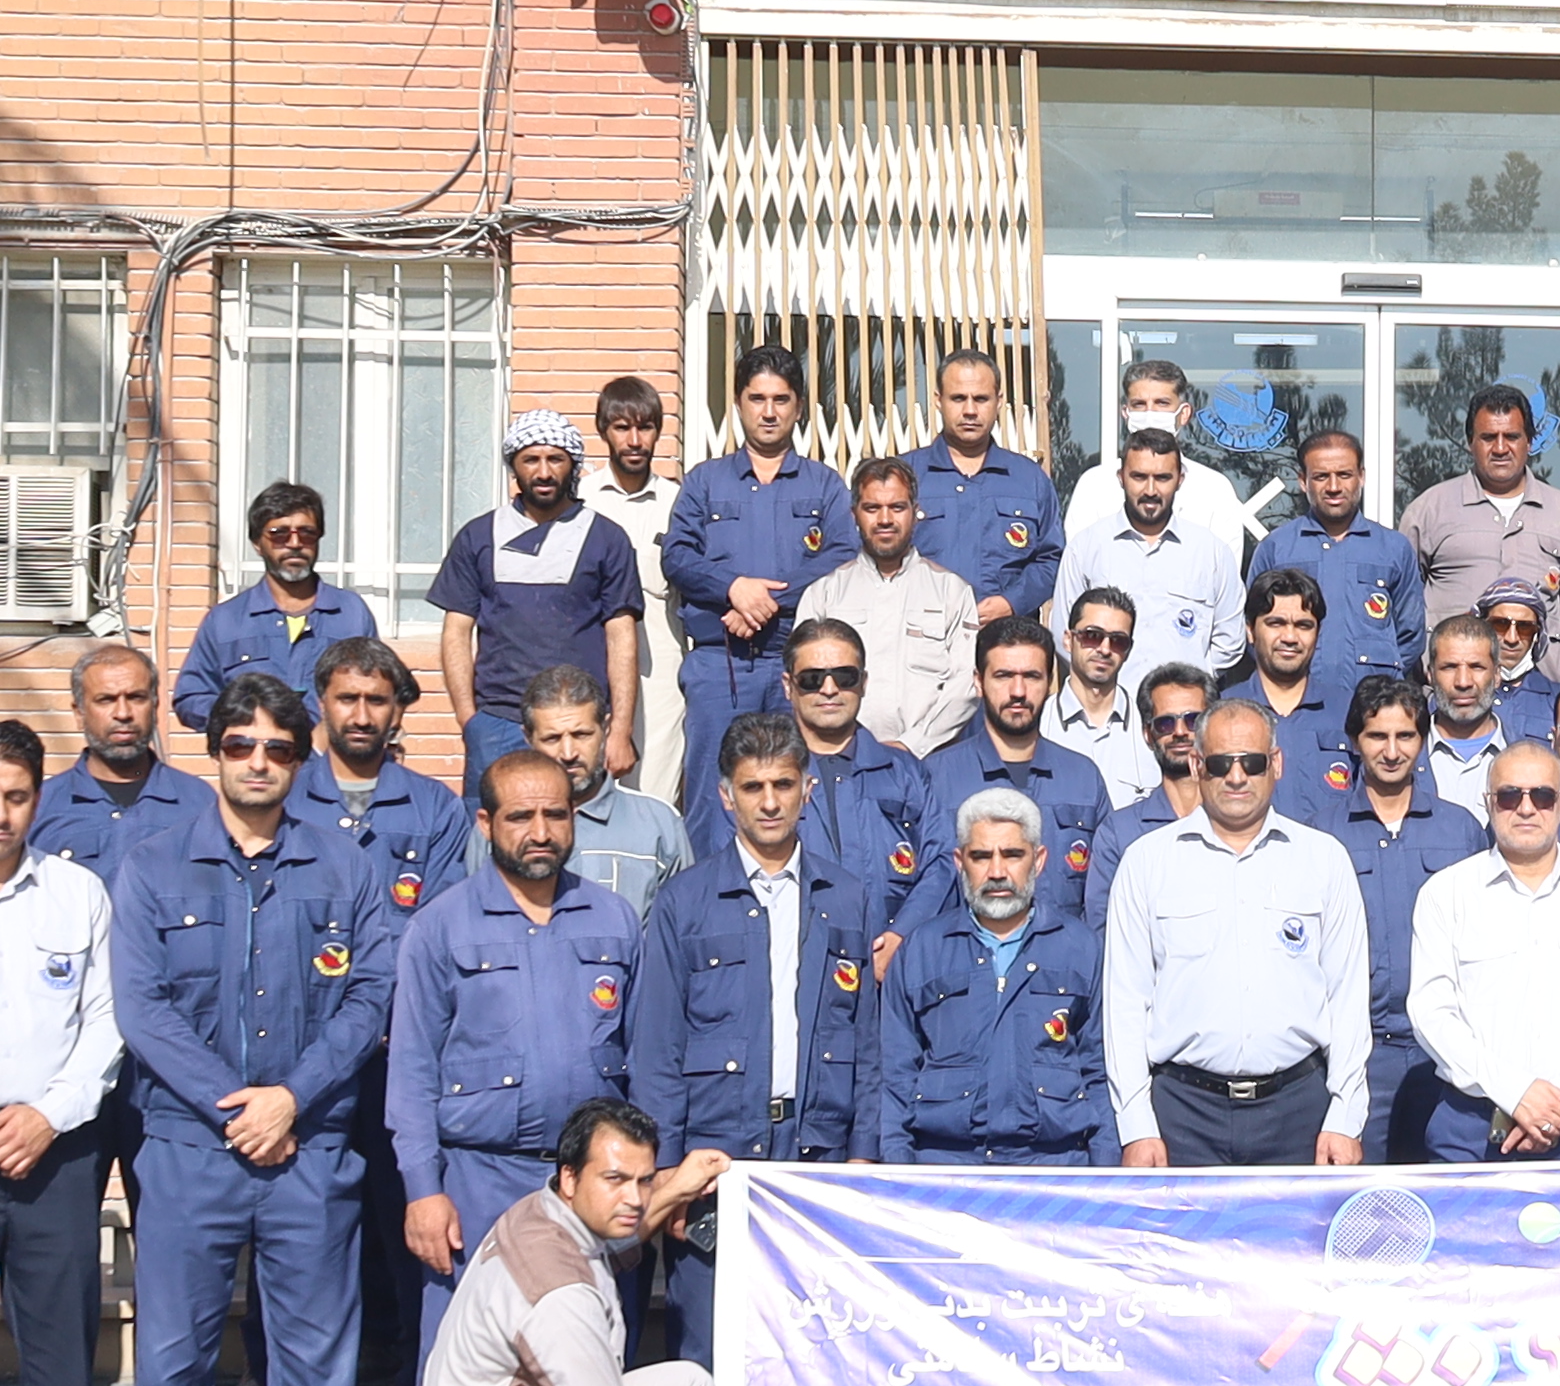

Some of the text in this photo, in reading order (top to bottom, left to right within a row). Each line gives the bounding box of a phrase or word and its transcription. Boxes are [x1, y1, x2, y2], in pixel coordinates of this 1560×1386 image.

[1001, 1286, 1107, 1333] تربیت
[888, 1335, 1125, 1386] نشاط سمتی
